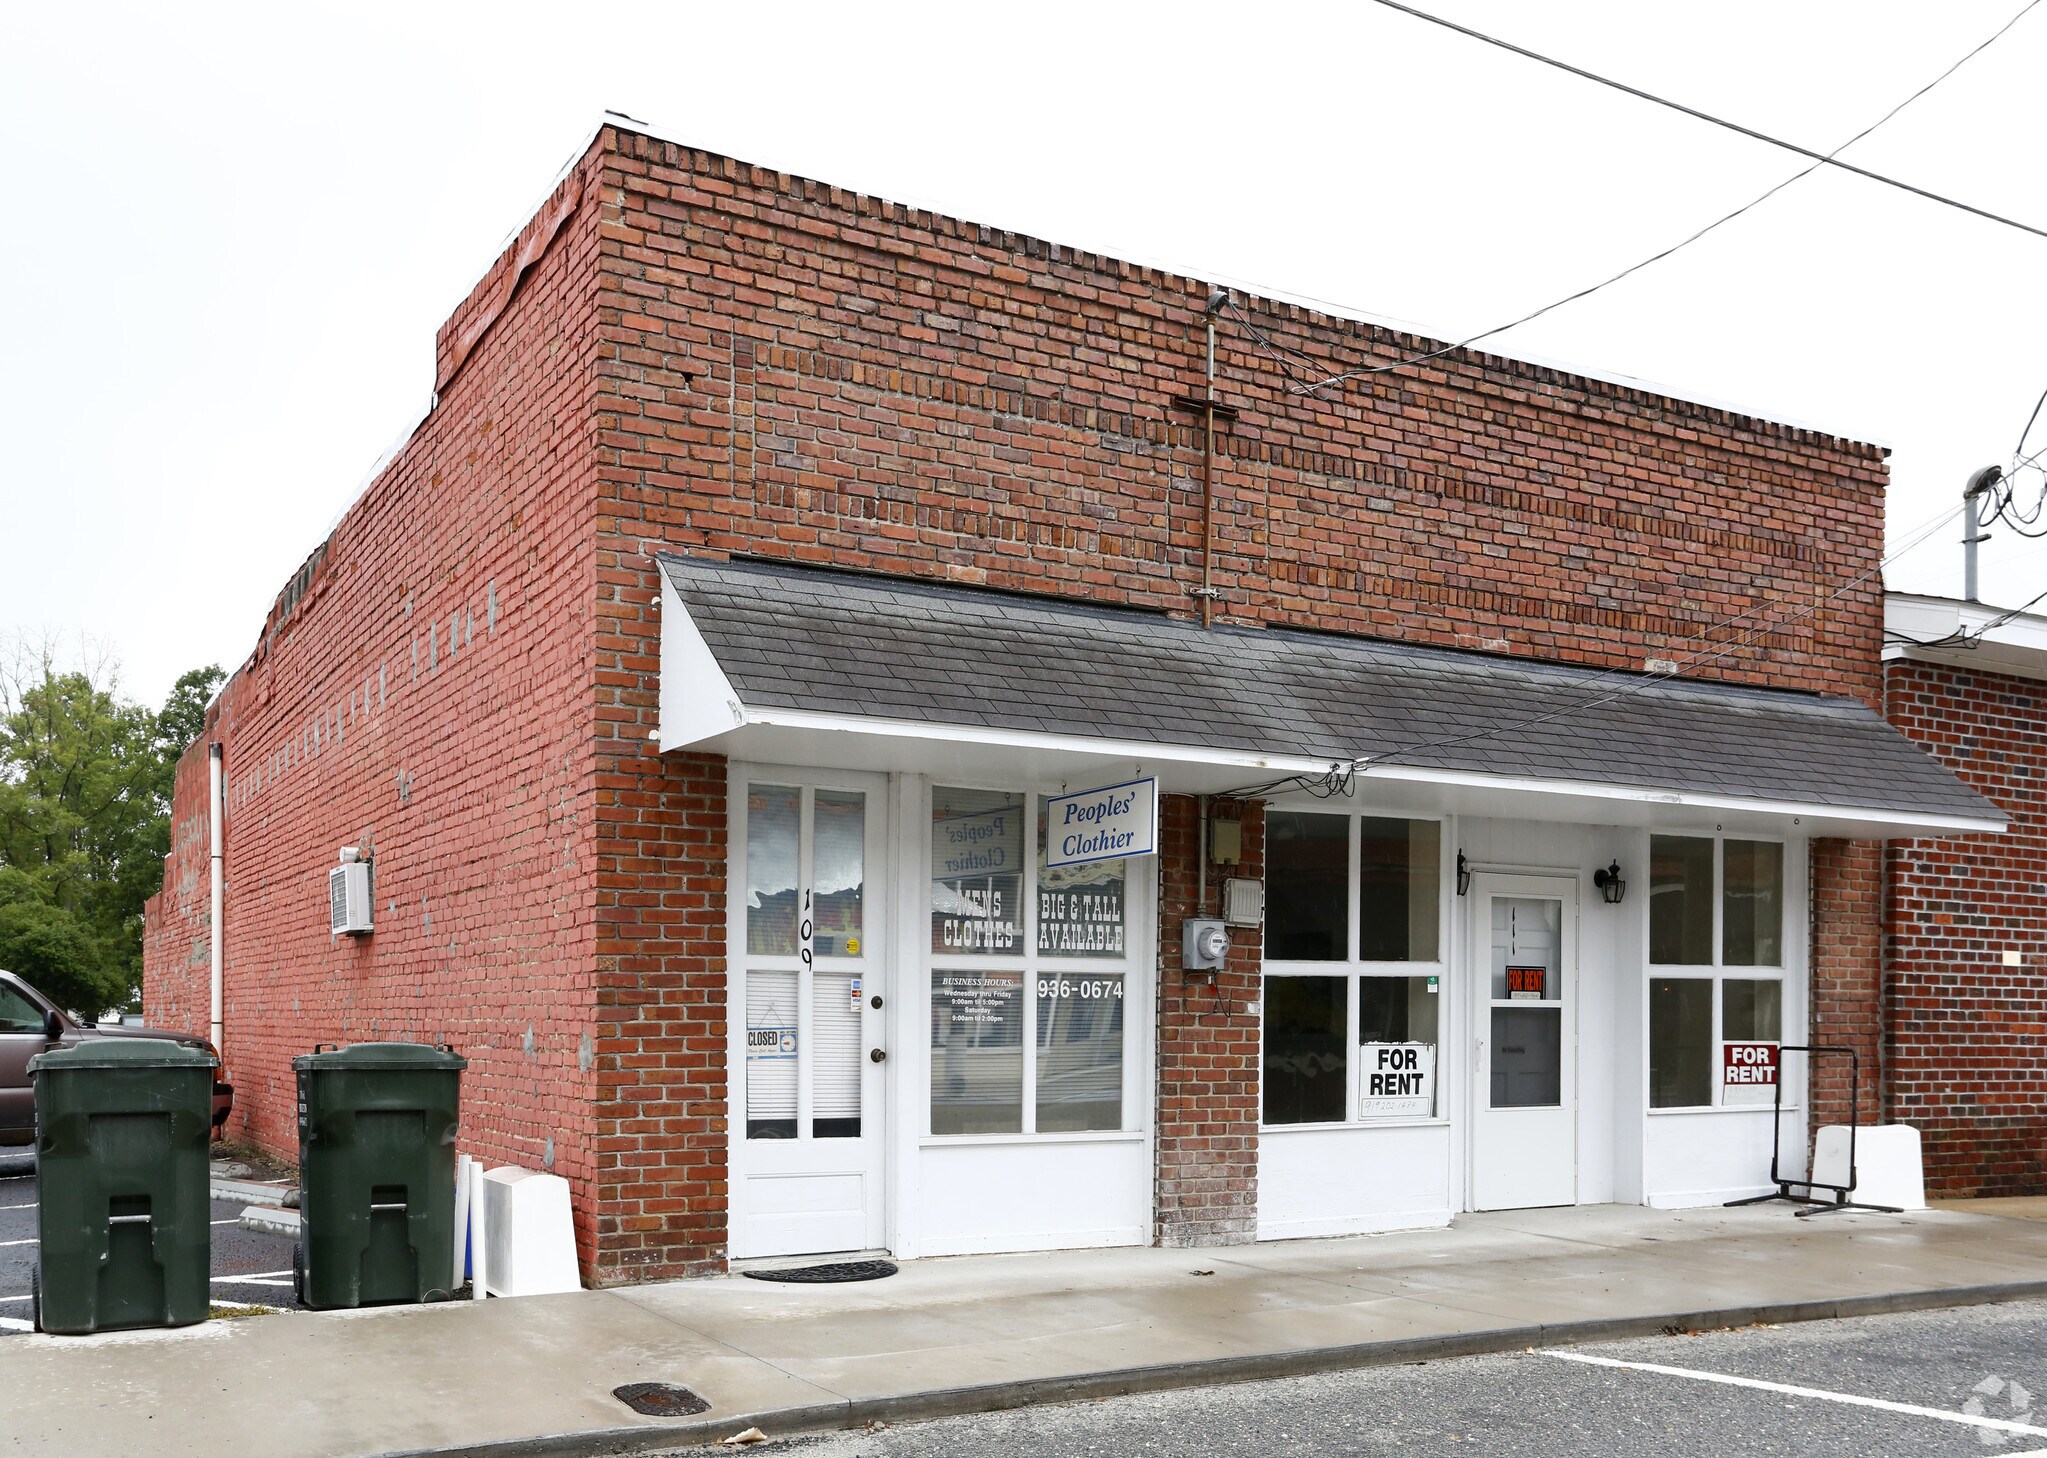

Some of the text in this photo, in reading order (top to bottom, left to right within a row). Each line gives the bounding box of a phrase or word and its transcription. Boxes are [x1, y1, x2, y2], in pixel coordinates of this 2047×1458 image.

[1063, 828, 1135, 856] Clothier
[956, 889, 1001, 918] MENS
[1041, 893, 1121, 922] BIG & TALL
[800, 888, 812, 972] 109
[944, 919, 1013, 948] CLOTHES
[1038, 922, 1123, 951] AVAILABLE
[942, 977, 1014, 987] BUSINESS HOURS:
[1037, 979, 1123, 999] 936-0674
[1509, 970, 1543, 990] FOR RENT
[943, 989, 978, 998] Wednesday
[993, 990, 1012, 998] Friday
[964, 1006, 991, 1015] Saturday
[981, 1015, 1004, 1023] 2:00pm
[748, 1031, 778, 1046] CLOSED
[1378, 1048, 1418, 1070] FOR
[1732, 1047, 1770, 1064] FOR
[1370, 1073, 1424, 1096] RENT
[1726, 1066, 1776, 1083] RENT
